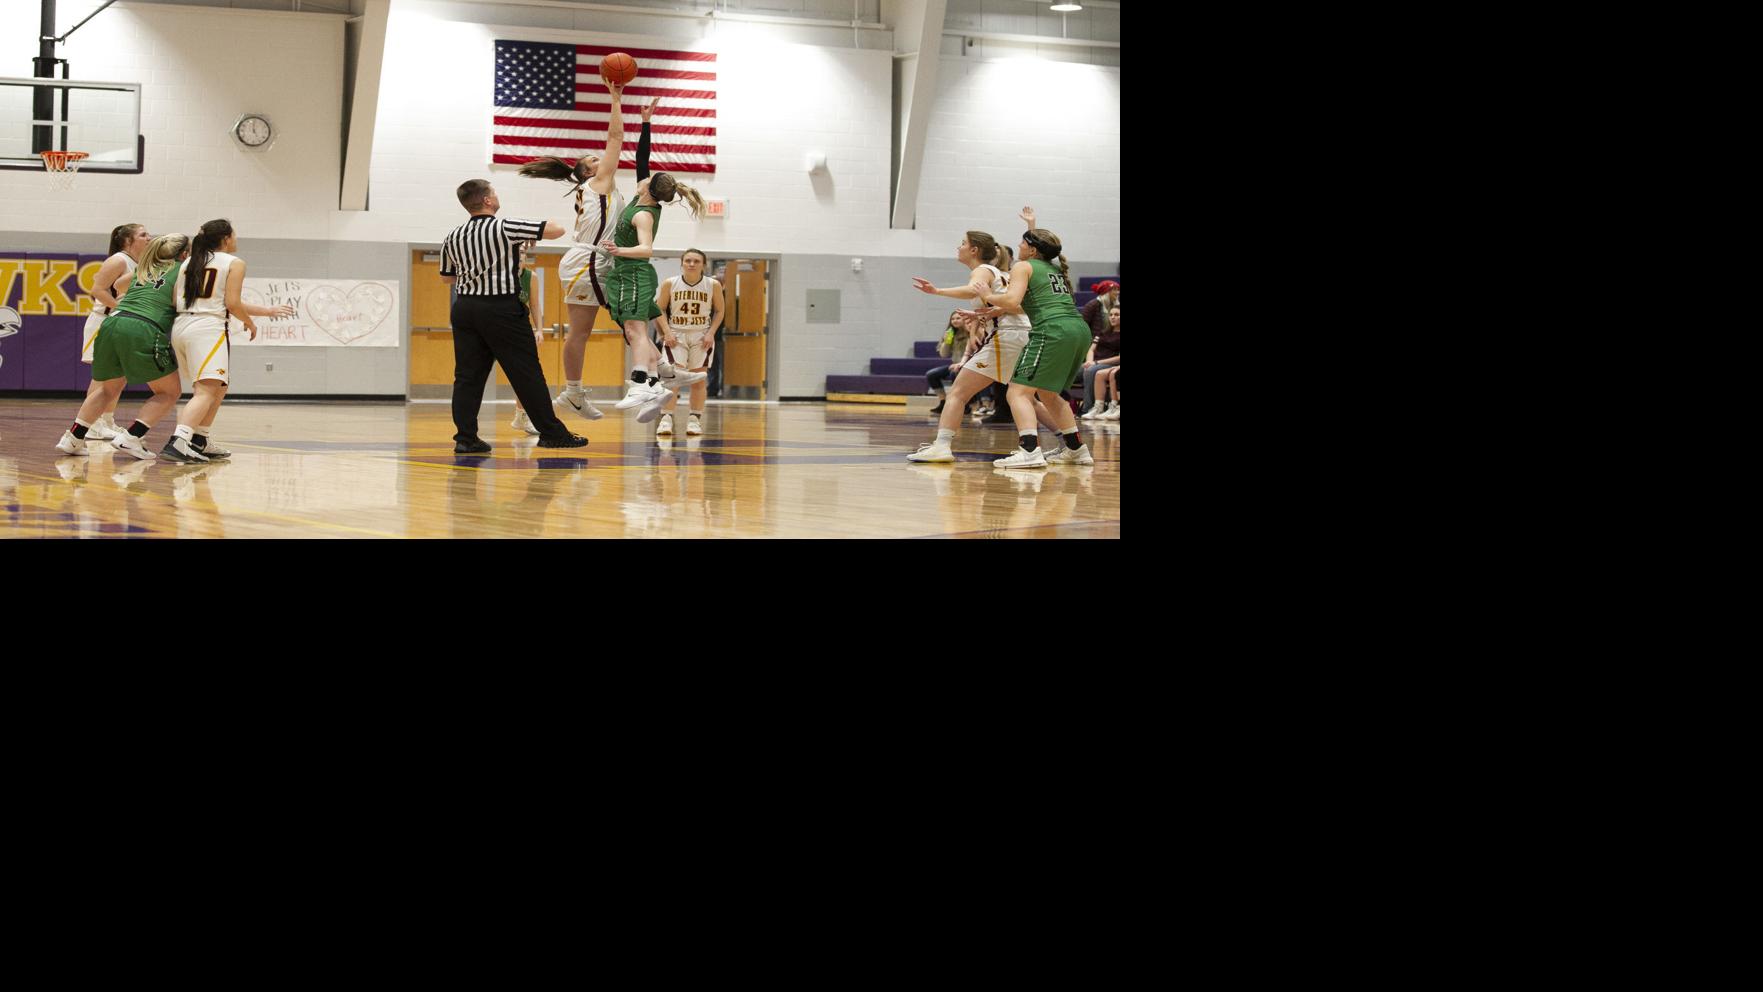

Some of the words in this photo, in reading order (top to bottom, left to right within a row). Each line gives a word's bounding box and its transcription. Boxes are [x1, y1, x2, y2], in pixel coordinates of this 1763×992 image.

[674, 290, 708, 303] STERLING
[680, 302, 700, 315] 43
[261, 324, 310, 341] HEART
